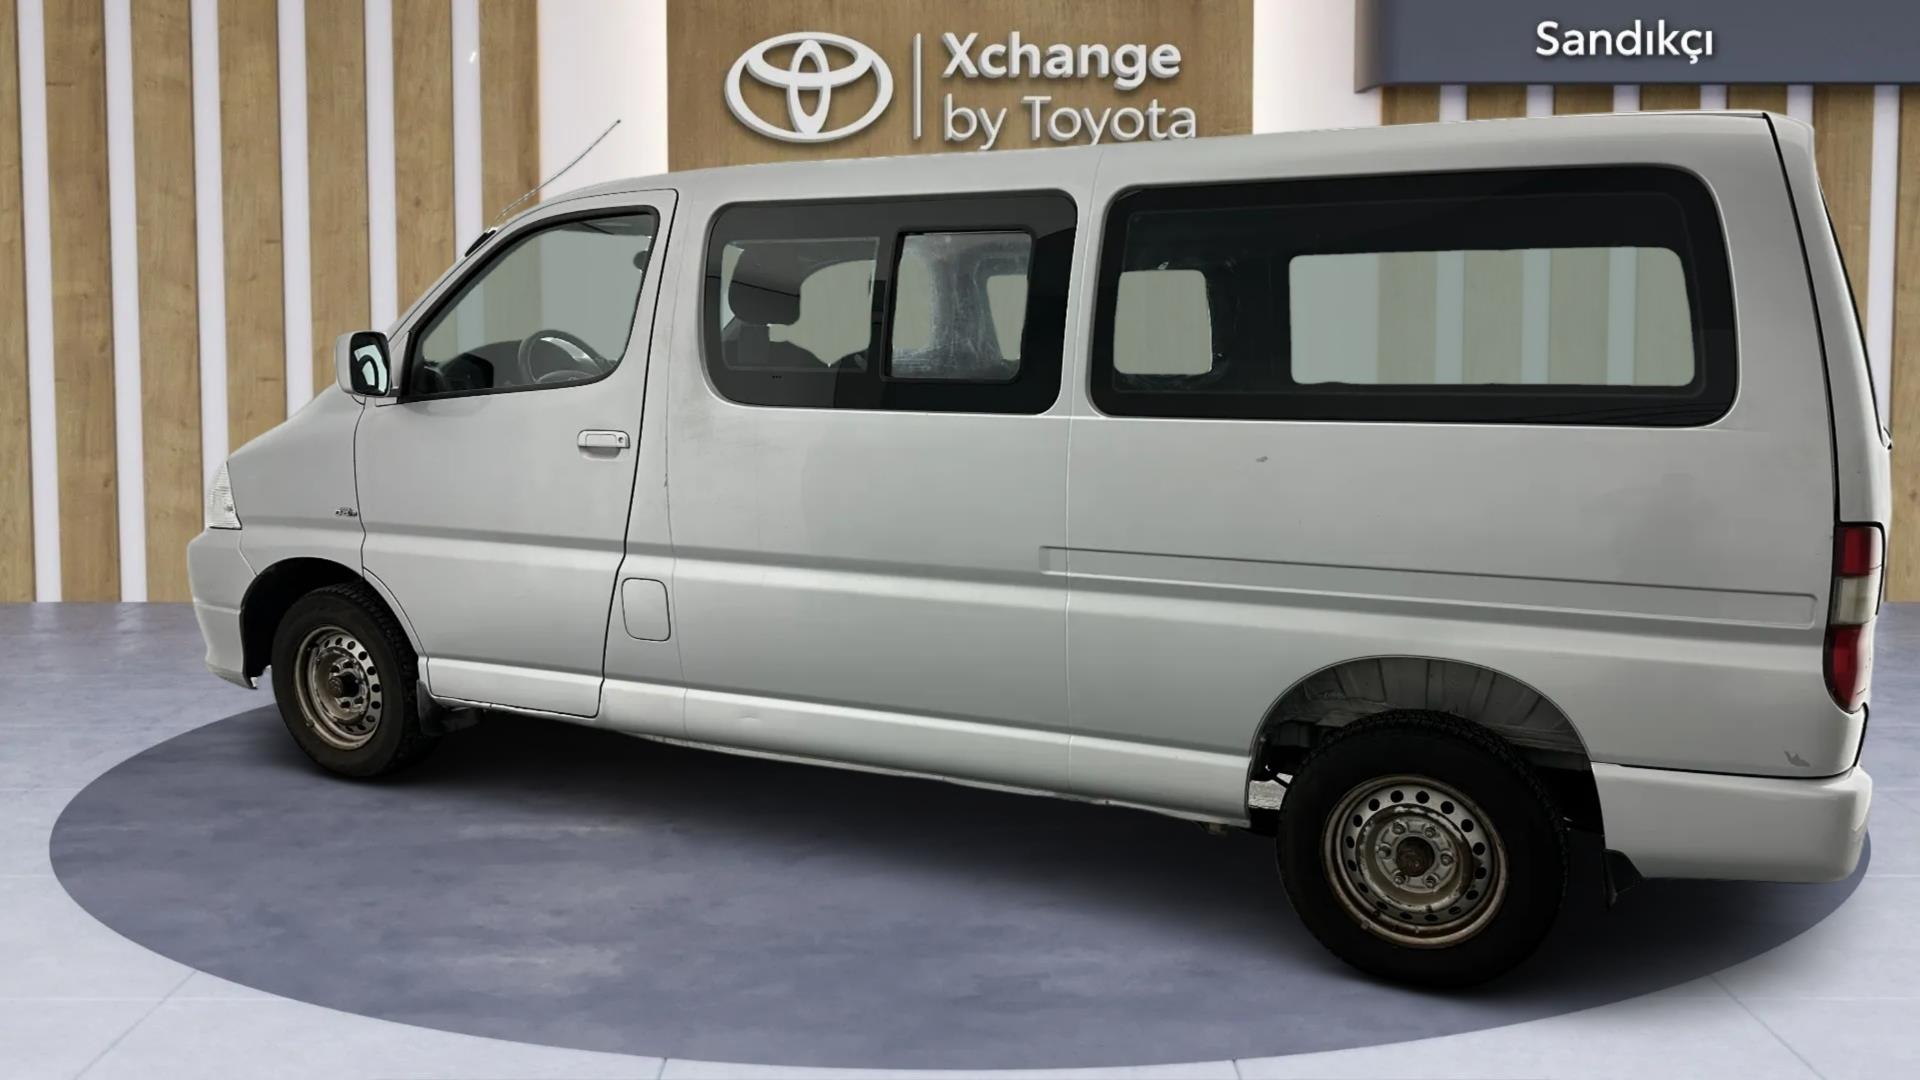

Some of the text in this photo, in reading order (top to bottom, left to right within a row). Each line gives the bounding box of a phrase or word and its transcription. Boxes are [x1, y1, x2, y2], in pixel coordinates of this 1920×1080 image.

[942, 31, 1181, 90] Xchange
[1536, 19, 1713, 64] Sandıkçı
[944, 93, 1197, 150] by Toyota
